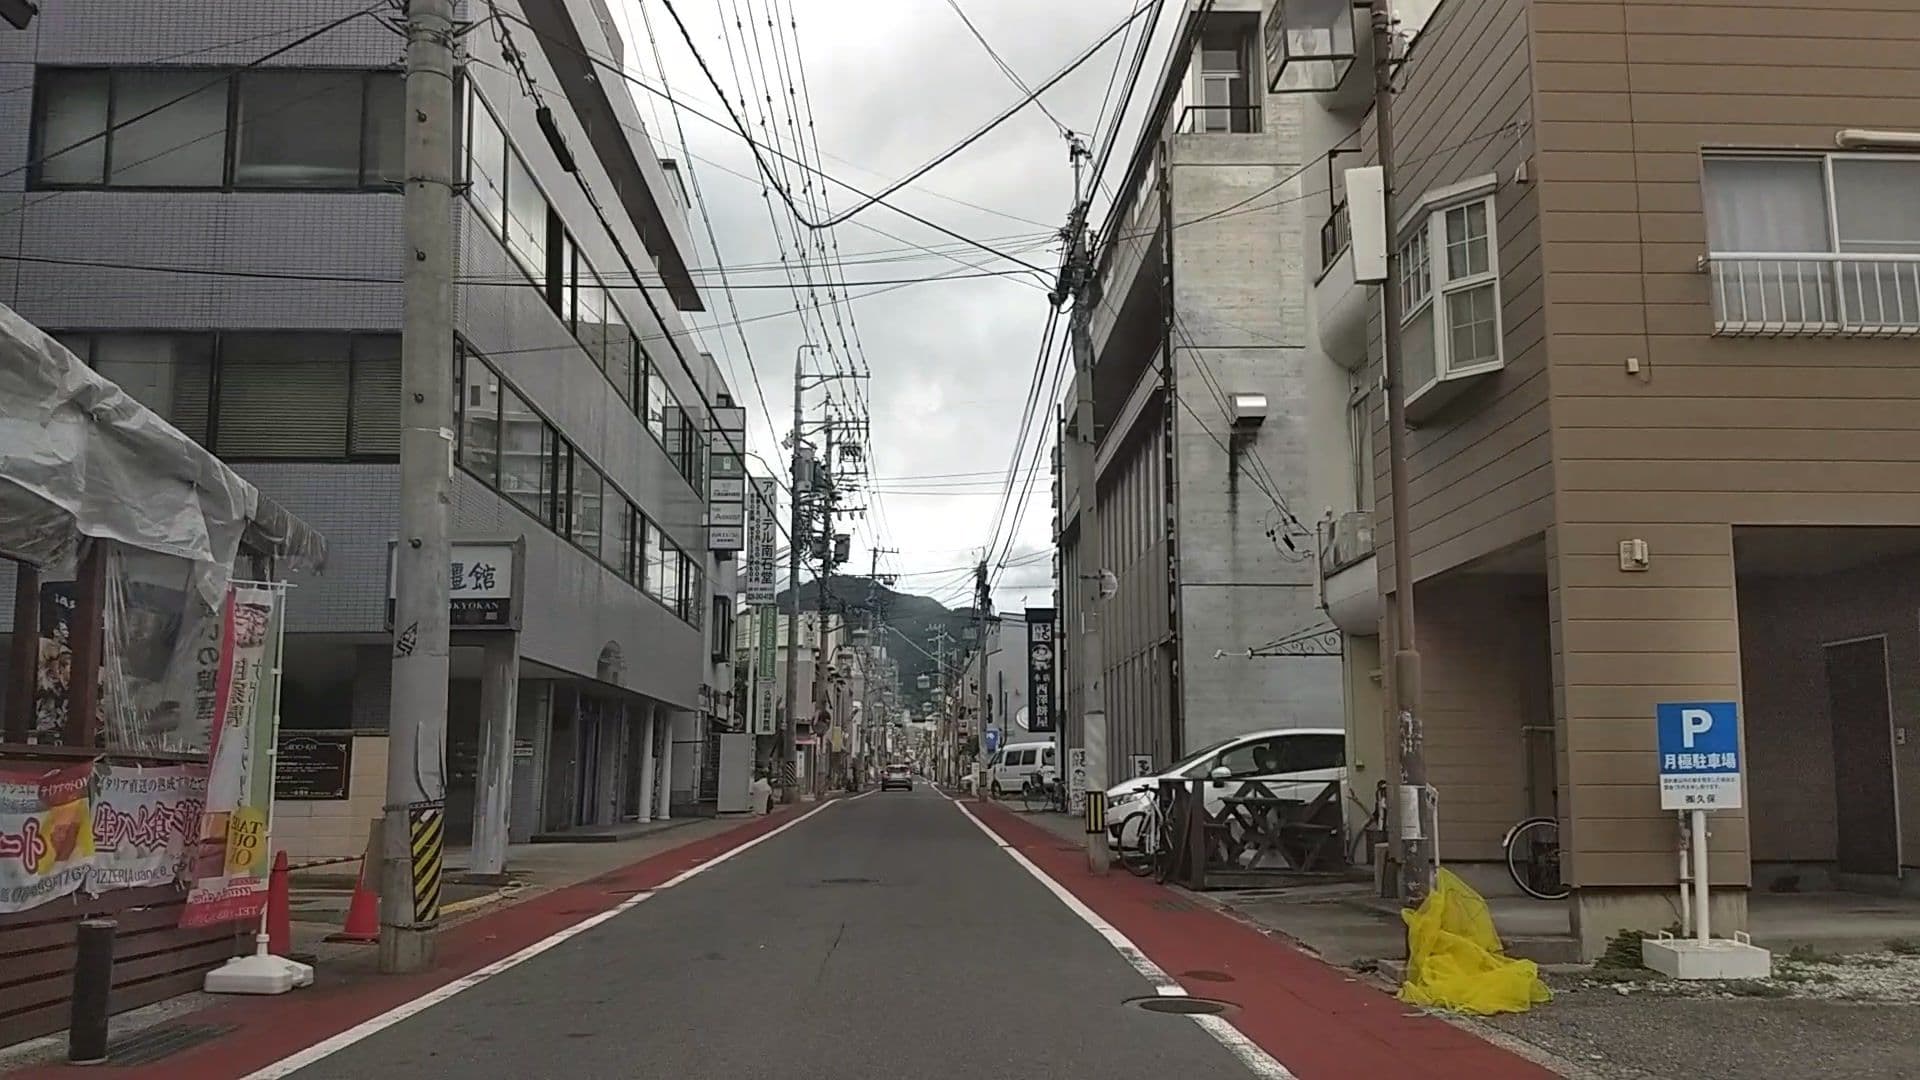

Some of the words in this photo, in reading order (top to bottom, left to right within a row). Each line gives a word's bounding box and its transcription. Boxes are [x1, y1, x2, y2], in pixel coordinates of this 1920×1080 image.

[1682, 709, 1713, 748] P
[1664, 752, 1737, 770] 月極駐車場
